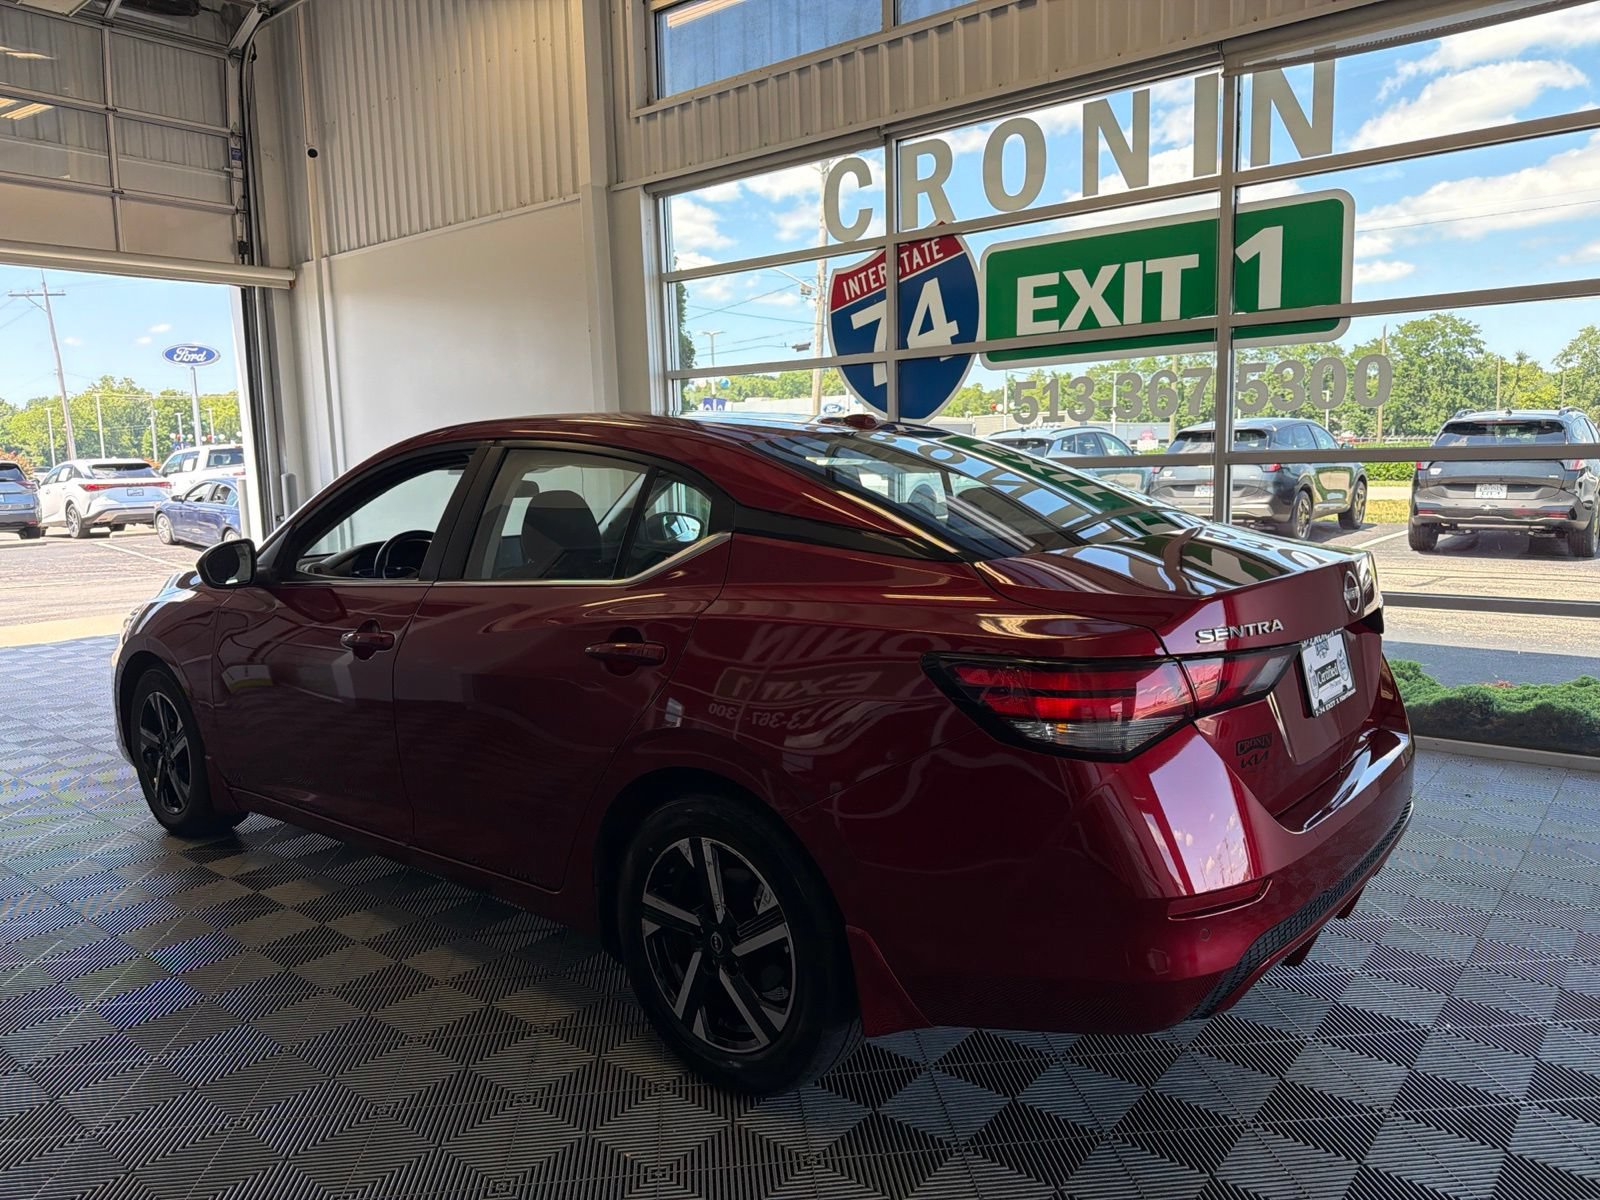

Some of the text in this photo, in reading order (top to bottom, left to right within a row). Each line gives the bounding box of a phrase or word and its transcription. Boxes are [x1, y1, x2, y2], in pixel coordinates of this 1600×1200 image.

[823, 47, 1337, 242] CRONIN
[842, 238, 944, 301] INTERTATE
[1016, 225, 1284, 337] EXIT 1
[173, 346, 207, 361] Ford
[850, 277, 960, 388] 74
[1197, 618, 1285, 645] SENTRA
